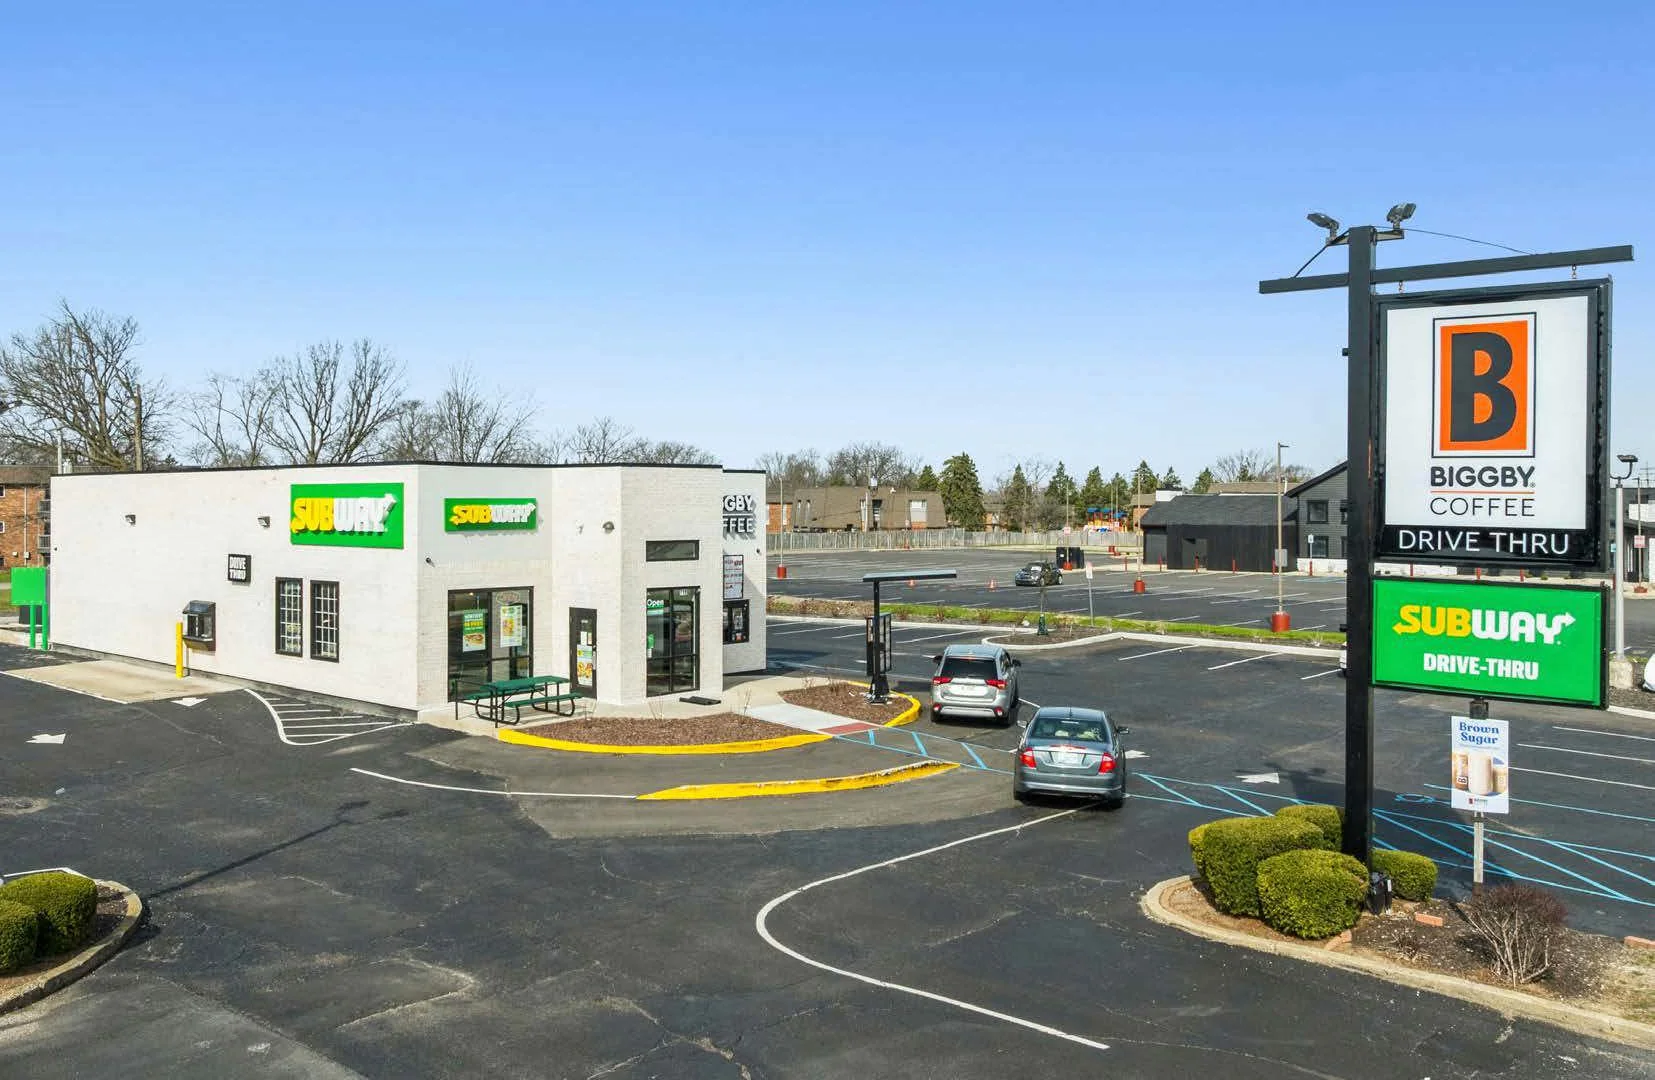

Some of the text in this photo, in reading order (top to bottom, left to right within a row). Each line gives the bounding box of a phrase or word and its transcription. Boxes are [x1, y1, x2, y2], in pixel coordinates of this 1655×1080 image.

[1450, 331, 1517, 442] B
[1430, 465, 1535, 488] BIGGBY
[290, 493, 397, 533] SUBWAY
[449, 502, 536, 525] SUBWAY
[1430, 497, 1535, 517] COFFEE
[1398, 530, 1569, 555] DRIVE THRU
[229, 556, 246, 569] DRIVE
[229, 569, 246, 580] THRU
[646, 598, 664, 608] Open
[1392, 604, 1576, 645] SUBWAY
[1423, 653, 1539, 681] DRIVE-THRU
[1459, 721, 1499, 734] Brown
[1460, 731, 1498, 745] Sugar
